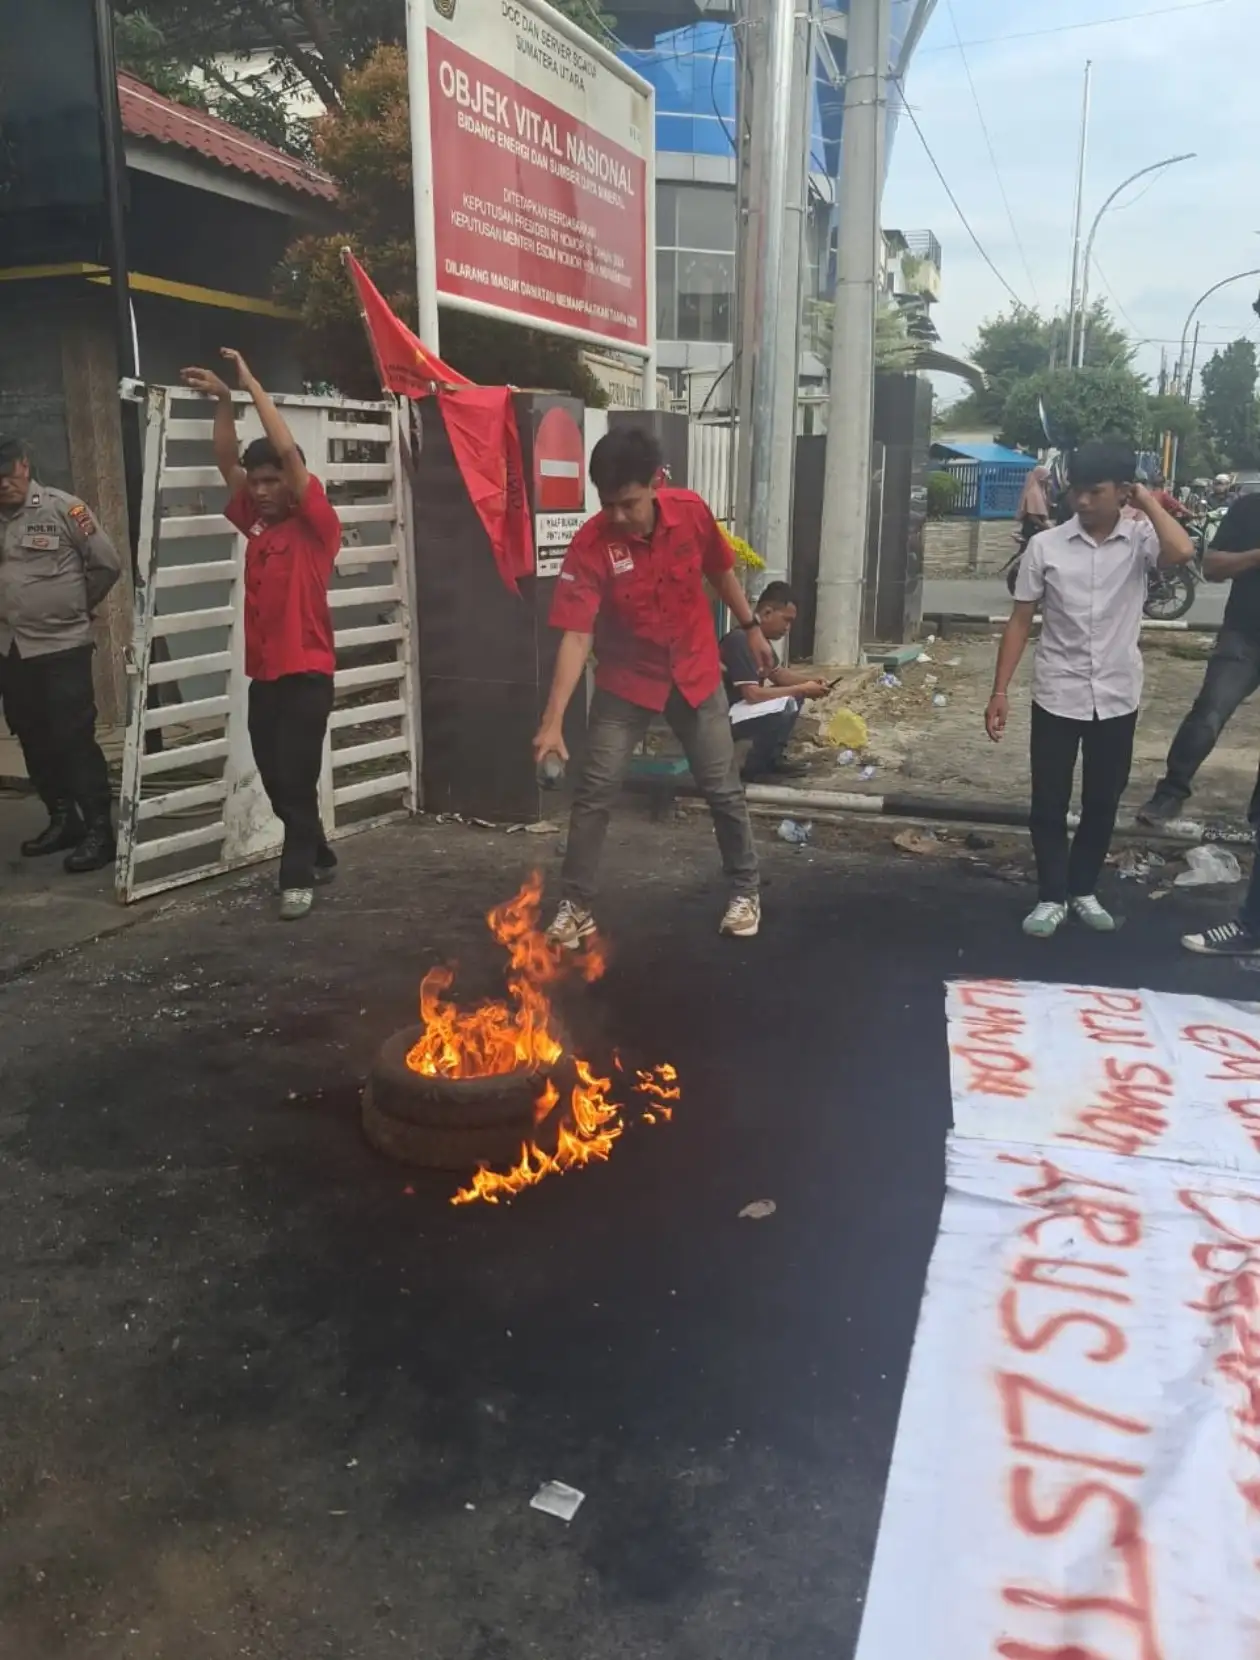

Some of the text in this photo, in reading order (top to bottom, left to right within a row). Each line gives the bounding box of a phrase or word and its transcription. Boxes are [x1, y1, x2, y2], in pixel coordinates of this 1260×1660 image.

[516, 35, 585, 92] SUMATERA UTARA
[522, 16, 539, 40] DAN
[541, 29, 572, 62] SERVER
[440, 60, 635, 196] OBJEK VITAL NASIONAL
[457, 111, 496, 143] BIDANG
[497, 131, 530, 162] ENERGI
[531, 148, 548, 170] DAN
[463, 192, 514, 226] KEPUTUSAN
[515, 212, 550, 239] PRESIDEN
[504, 188, 548, 219] DITETAPKAN
[451, 210, 502, 242] KEPUTUSAN
[503, 230, 535, 253] MENTERI
[536, 241, 556, 261] ESDM
[445, 259, 489, 285] DILARANG
[491, 272, 520, 292] MASUK
[27, 523, 56, 533] POLRI
[997, 1152, 1140, 1364] ARUS
